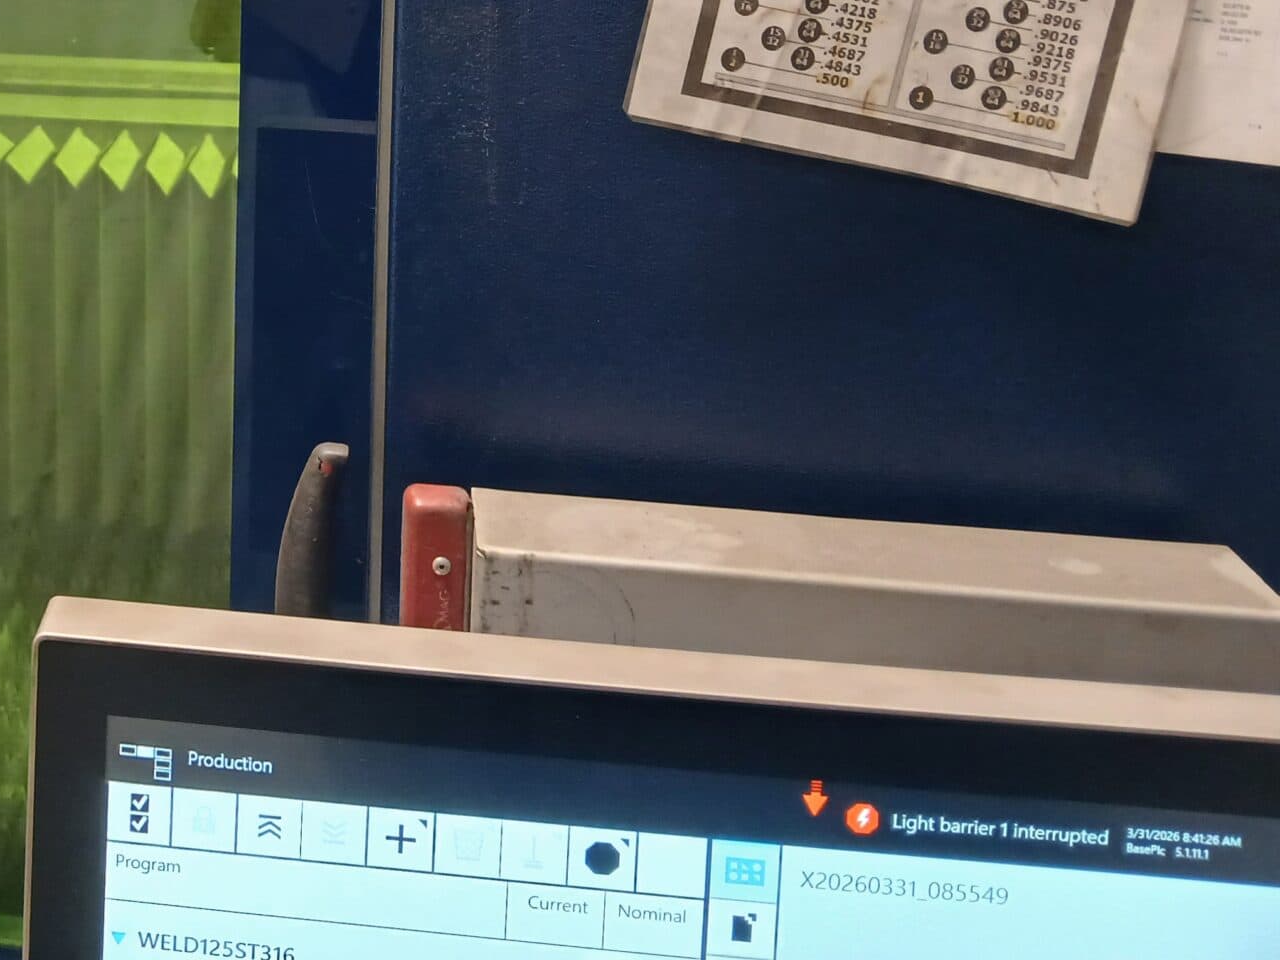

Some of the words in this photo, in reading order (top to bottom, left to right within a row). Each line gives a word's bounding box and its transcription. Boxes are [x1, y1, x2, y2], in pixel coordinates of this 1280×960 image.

[835, 2, 877, 19] .4218
[1042, 0, 1076, 14] .875
[831, 17, 873, 33] .4375
[1038, 14, 1081, 31] .8906
[828, 31, 868, 48] .4531
[1034, 28, 1078, 46] .9026
[824, 45, 865, 62] .4687
[1030, 42, 1075, 60] .9218
[820, 60, 862, 76] .4843
[1027, 56, 1071, 73] .9375
[816, 73, 849, 88] .500
[1023, 70, 1066, 87] .9531
[1020, 85, 1064, 102] .9687
[1016, 99, 1059, 116] .9843
[1012, 112, 1055, 130] 1.000
[187, 750, 273, 773] Production
[892, 812, 935, 835] Light
[940, 816, 995, 838] barrier
[1000, 821, 1008, 837] 1
[1013, 823, 1109, 846] interrupted
[1127, 827, 1180, 842] 3/31/2026
[1182, 832, 1220, 846] 8:41:26
[1221, 835, 1242, 848] AM
[115, 854, 181, 874] Program
[799, 869, 1009, 906] X20260331_085549
[527, 895, 588, 915] Current
[617, 904, 687, 923] Nominal
[137, 930, 295, 960] WELD125ST316
